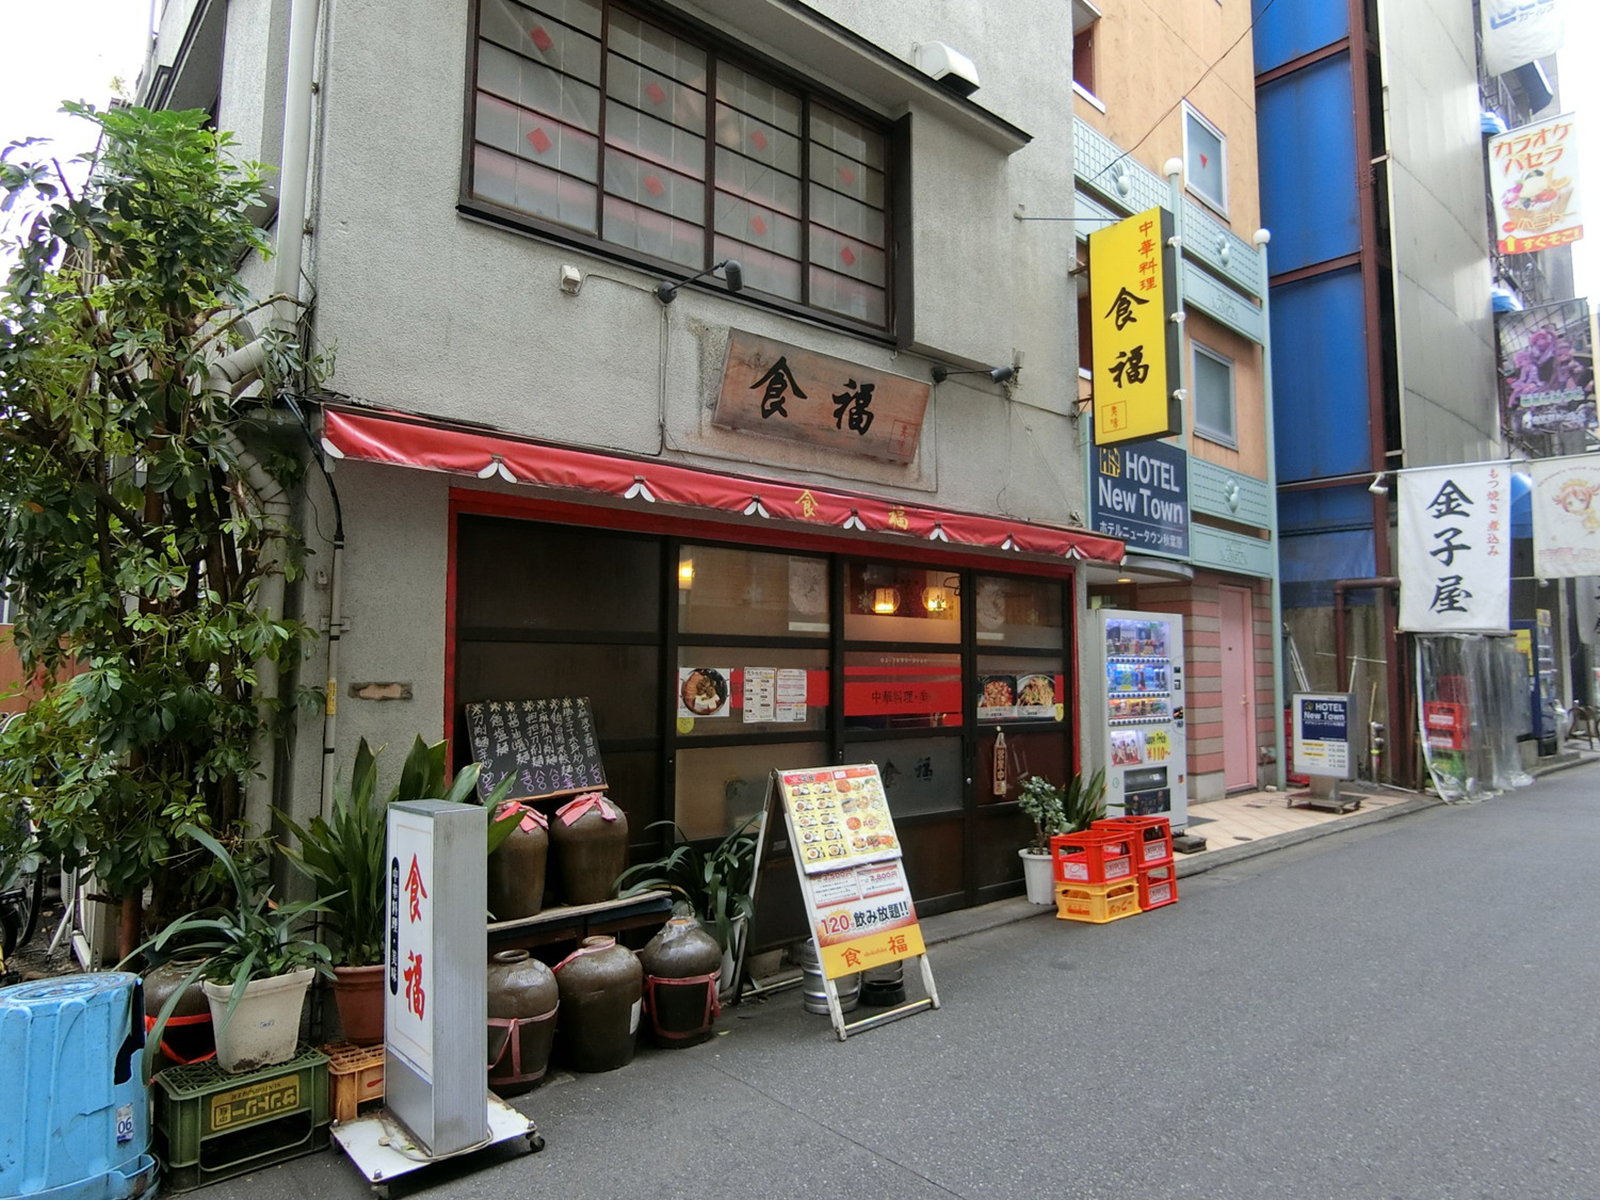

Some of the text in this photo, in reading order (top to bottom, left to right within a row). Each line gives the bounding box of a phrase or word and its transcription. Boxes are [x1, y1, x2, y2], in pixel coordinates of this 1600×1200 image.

[1494, 122, 1573, 157] カラオケ
[1504, 144, 1565, 175] パセラ
[1138, 220, 1158, 292] 中華料理
[1103, 286, 1150, 389] 食福
[750, 356, 875, 436] 食福
[1125, 450, 1181, 494] HOTEL
[1098, 476, 1184, 524] New Town
[1486, 467, 1501, 557] もつ焼き 煮込み
[1099, 520, 1183, 549] ホテルニュータウン秋葉原
[1425, 479, 1475, 615] 金子屋
[1304, 711, 1345, 721] New Town
[1315, 703, 1345, 712] HOTEL
[404, 852, 428, 1022] 食福
[232, 1088, 296, 1117] サントリー
[117, 1116, 132, 1135] 06
